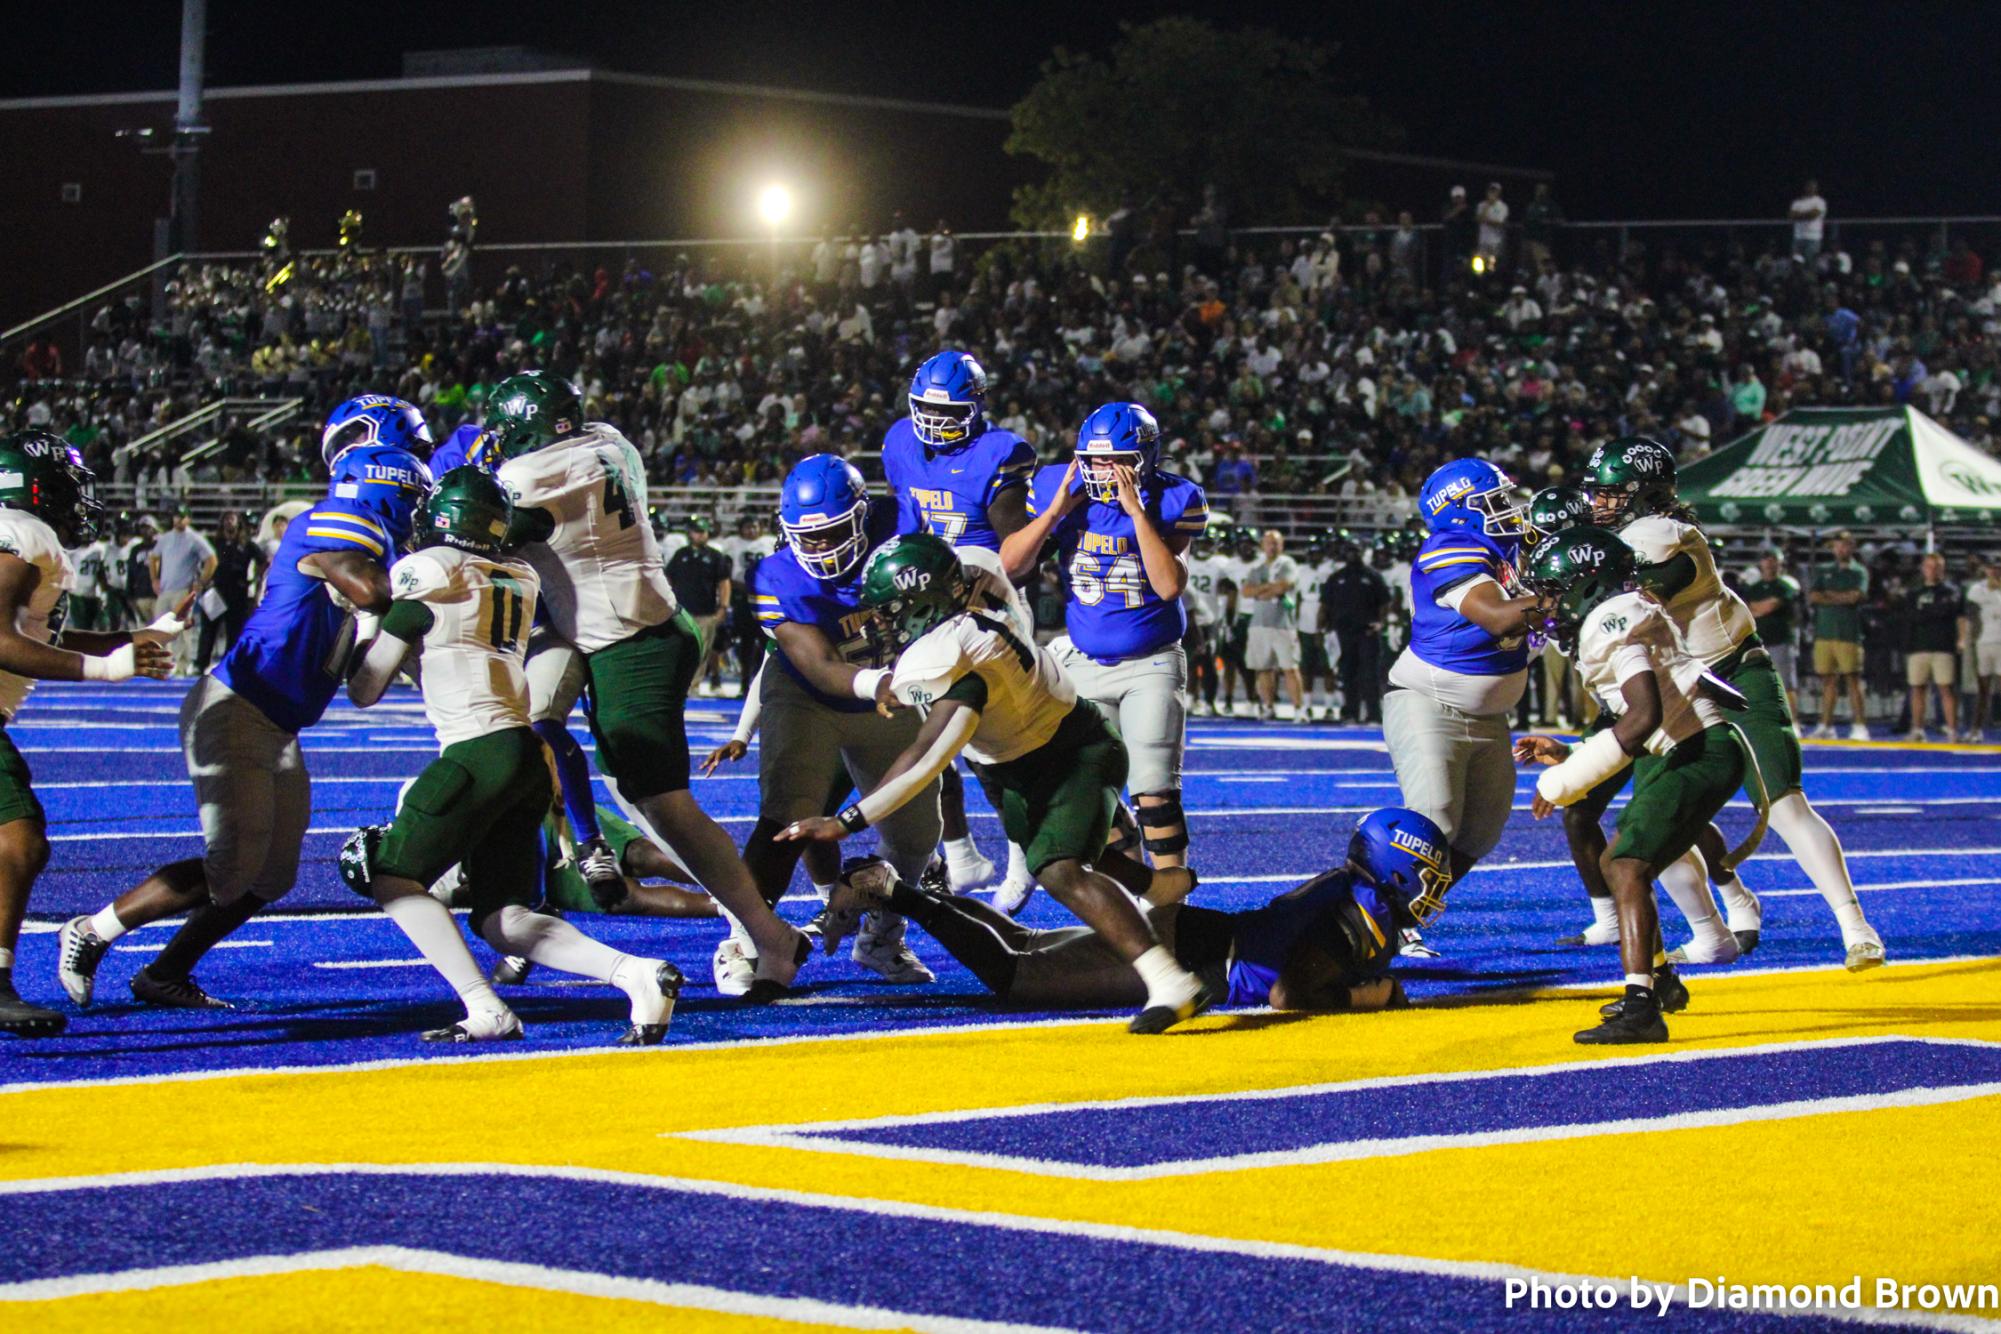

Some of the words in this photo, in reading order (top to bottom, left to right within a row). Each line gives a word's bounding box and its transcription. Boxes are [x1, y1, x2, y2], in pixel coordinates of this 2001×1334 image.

[1746, 424, 1832, 466] WEST
[1811, 417, 1906, 464] POINT
[1426, 476, 1472, 511] TUPELO
[1568, 544, 1606, 567] WP
[893, 566, 932, 591] WP
[1069, 549, 1145, 609] 64
[1394, 829, 1442, 866] TUPELO
